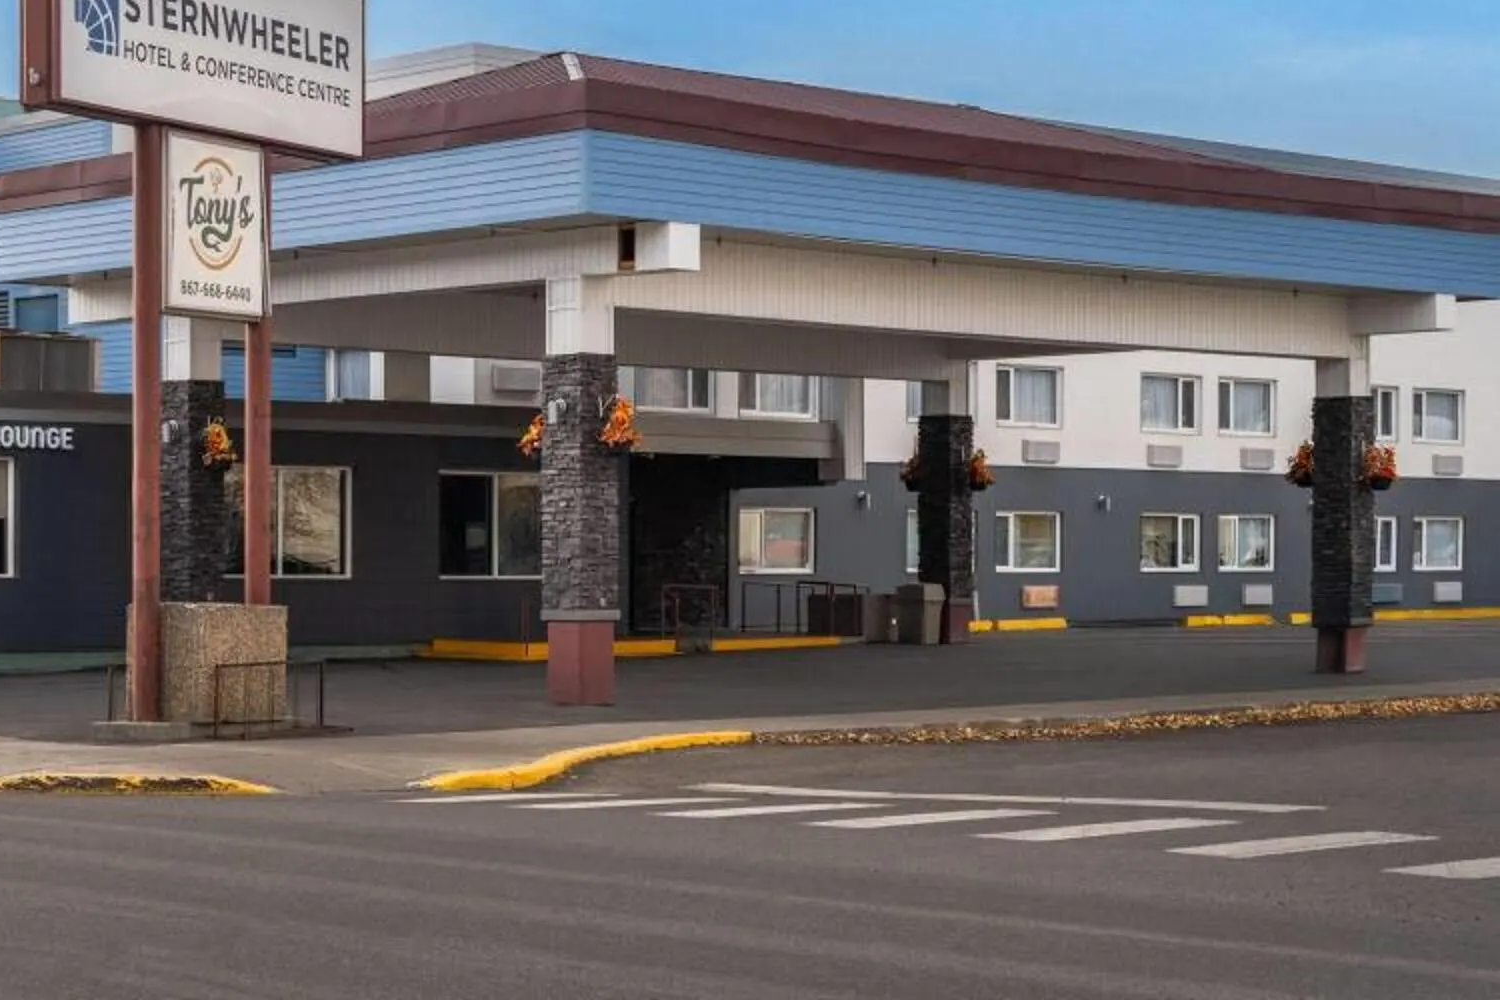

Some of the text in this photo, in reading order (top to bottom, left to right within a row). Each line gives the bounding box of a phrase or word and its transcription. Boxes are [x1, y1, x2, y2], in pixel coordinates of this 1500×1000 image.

[124, 39, 351, 107] HOTEL & CONFERENCE CENTRE
[179, 174, 255, 253] Tony's
